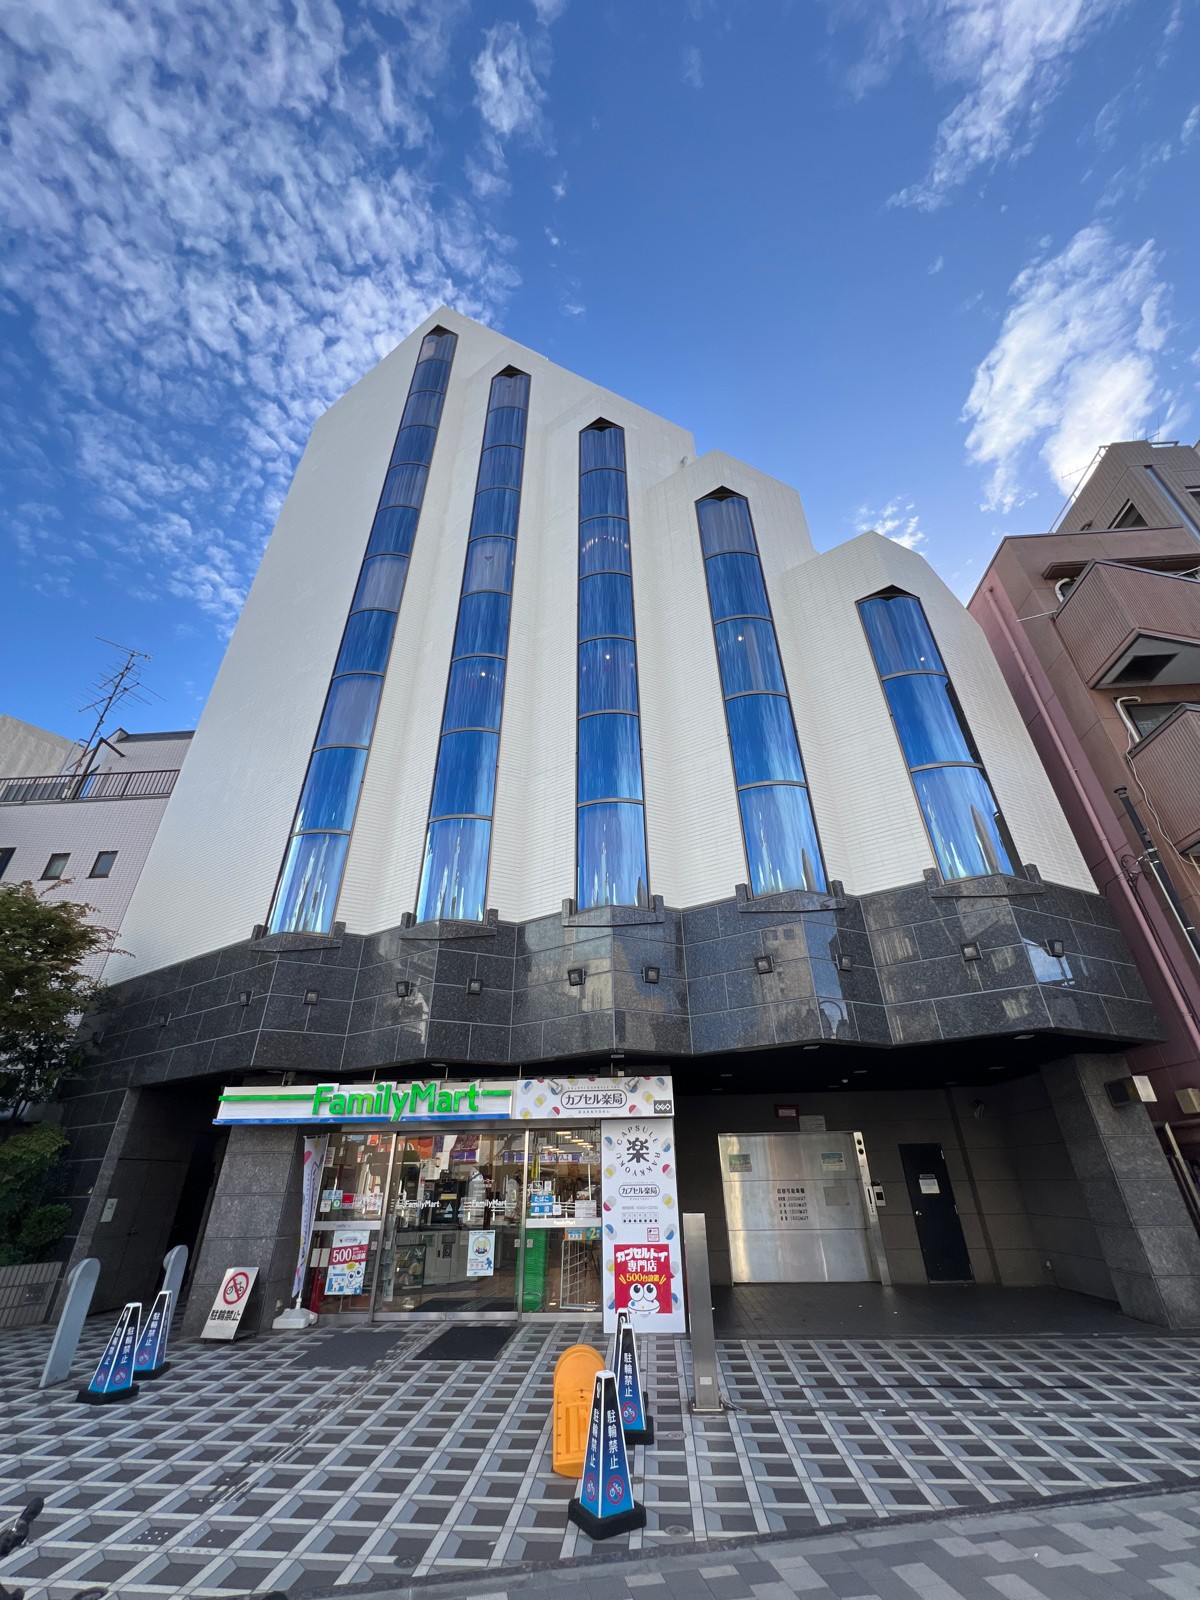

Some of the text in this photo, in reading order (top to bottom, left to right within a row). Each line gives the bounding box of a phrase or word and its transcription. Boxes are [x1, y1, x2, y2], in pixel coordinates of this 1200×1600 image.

[312, 1083, 480, 1122] FamilyMart
[565, 1093, 623, 1106] カプセル楽局
[655, 1103, 671, 1111] GEO
[617, 1125, 658, 1145] CAPSULE
[627, 1137, 649, 1163] 楽
[616, 1152, 661, 1176] RAKKYOKU
[621, 1187, 658, 1195] カプセル楽局
[404, 1200, 440, 1209] FamilyMart
[471, 1199, 507, 1208] FamilyMart
[332, 1248, 352, 1262] 500
[615, 1247, 668, 1263] カプセルトイ
[627, 1260, 657, 1272] 専門店
[626, 1273, 659, 1282] 500台設置
[209, 1310, 241, 1321] 駐輪禁止
[120, 1326, 135, 1364] 駐輪禁止
[623, 1352, 633, 1398] 駐輪禁止
[606, 1409, 619, 1470] 駐輪禁止
